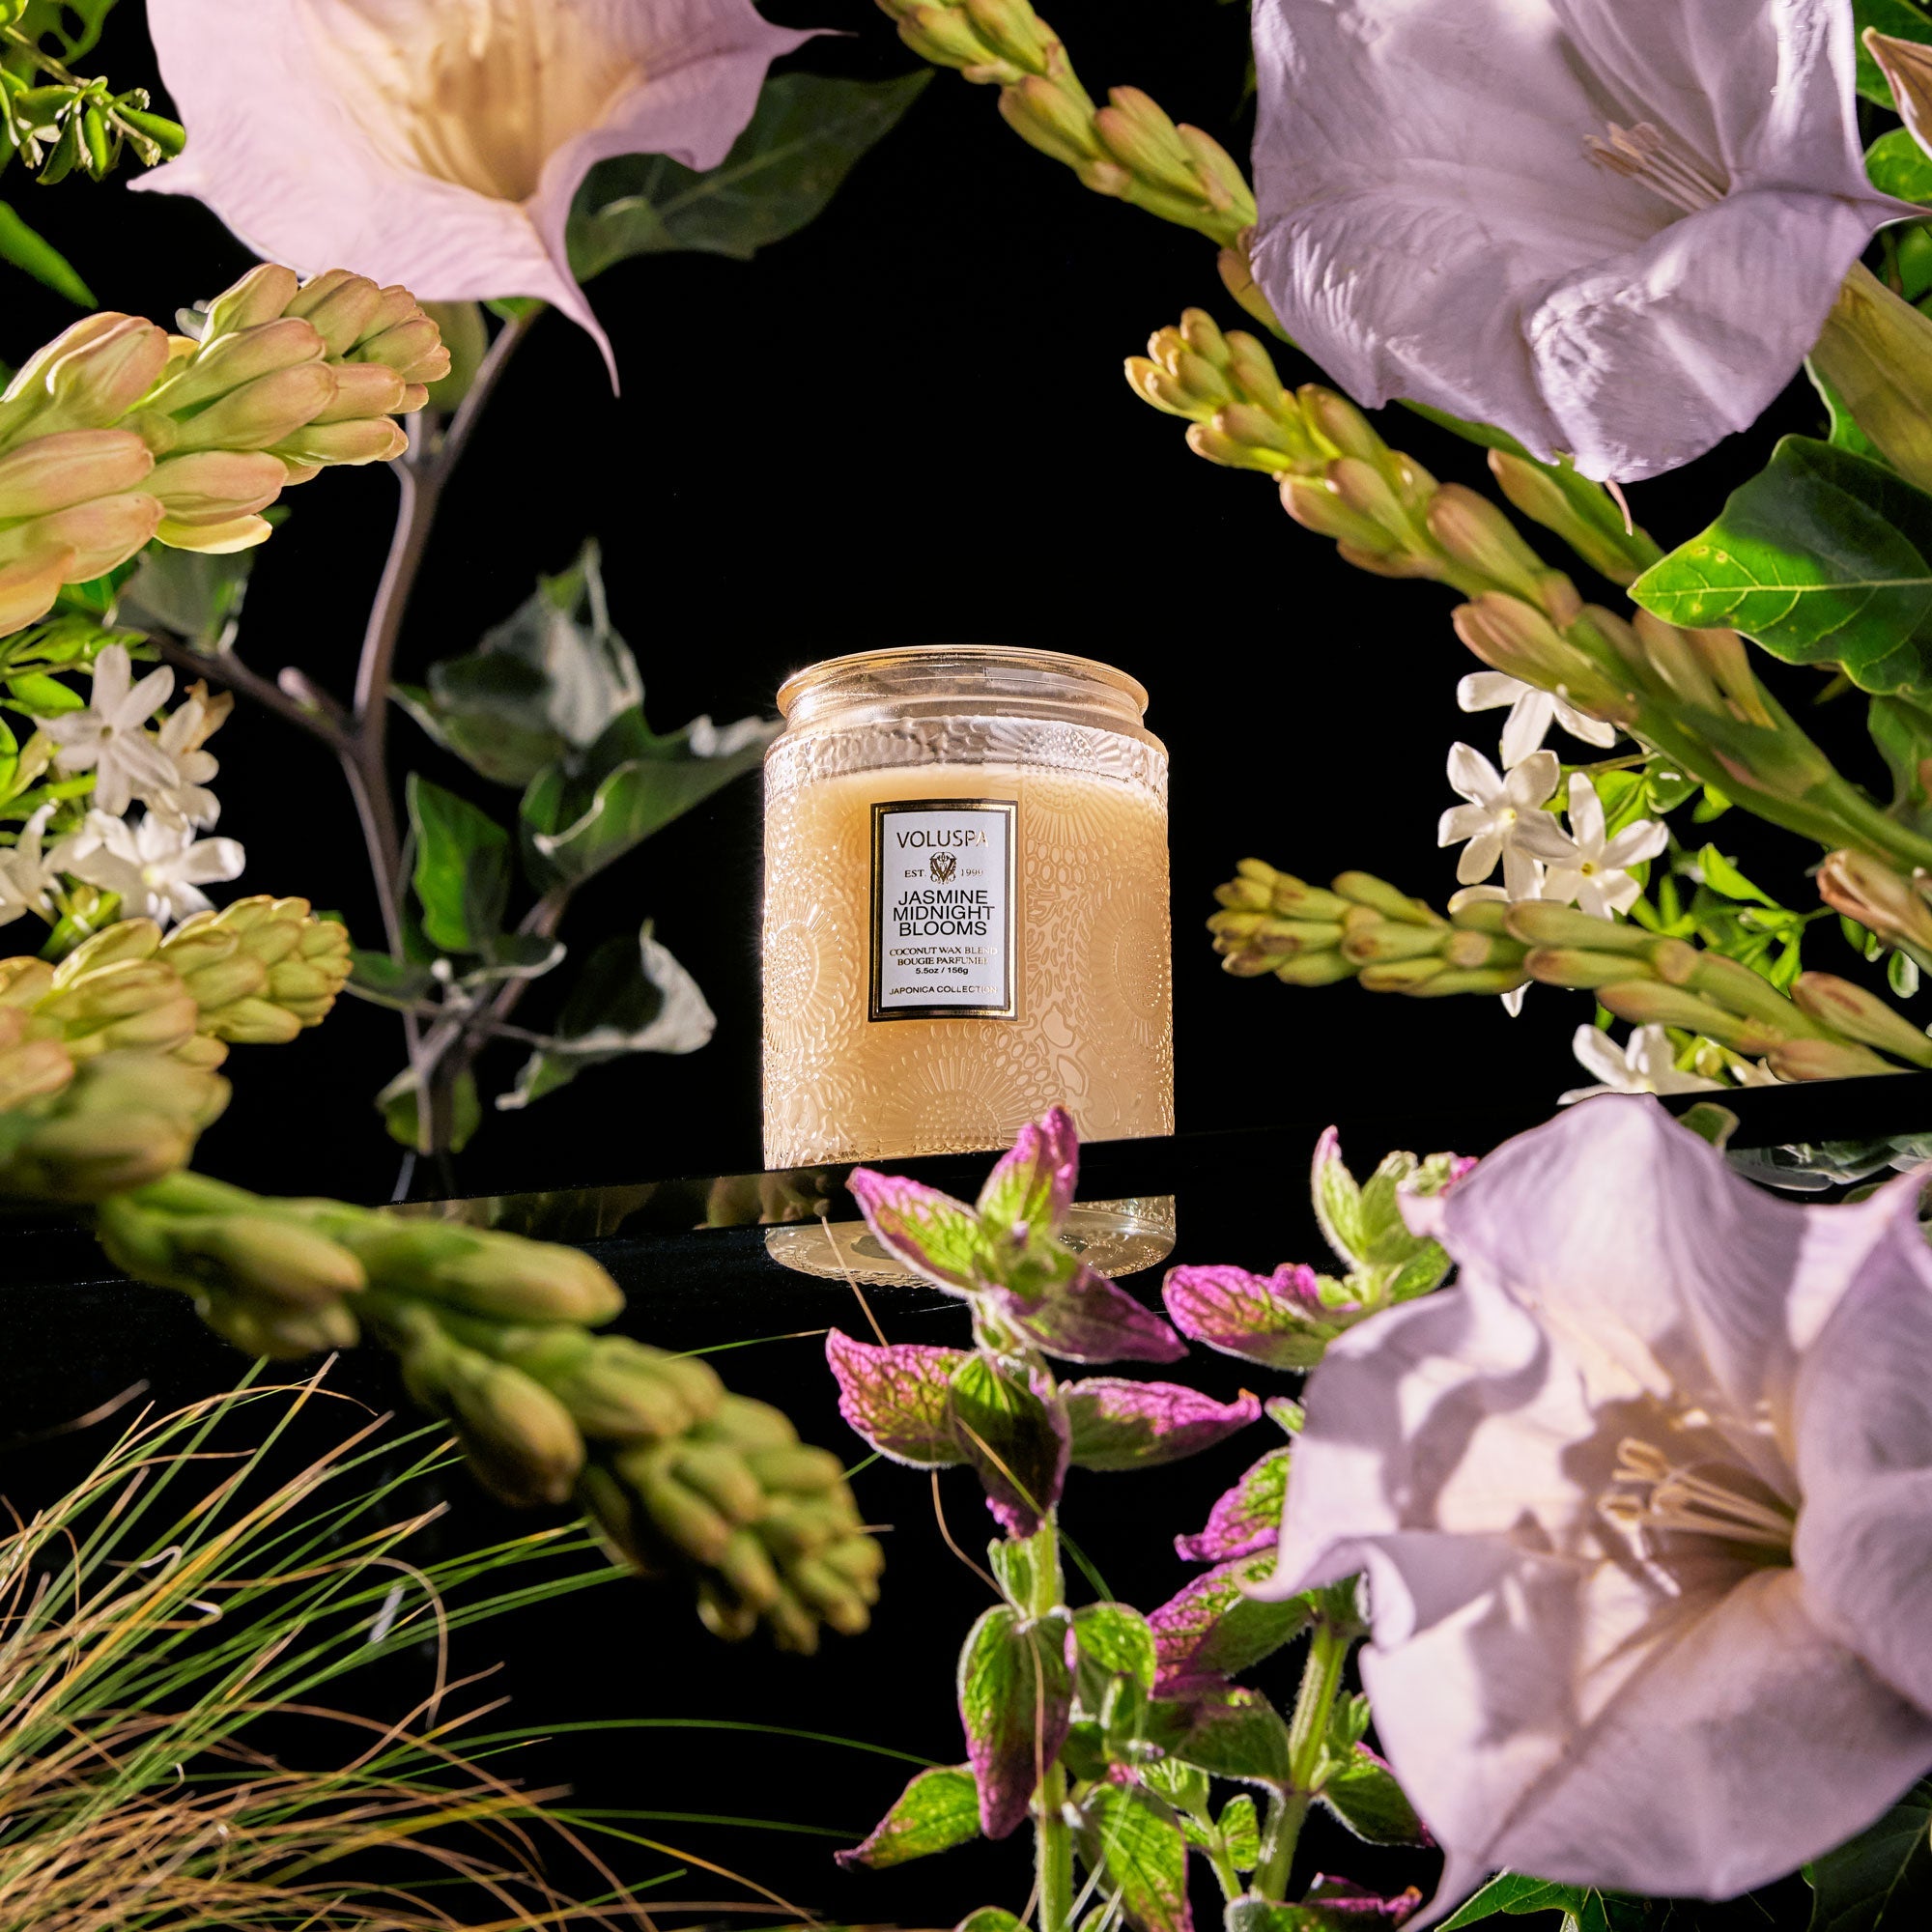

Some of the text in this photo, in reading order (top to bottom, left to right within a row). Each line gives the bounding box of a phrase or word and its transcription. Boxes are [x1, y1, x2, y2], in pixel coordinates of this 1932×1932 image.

[896, 830, 989, 848] VOLUSPA
[904, 869, 926, 878] EST.
[961, 868, 983, 877] 1999
[898, 890, 988, 906] JASMINE
[893, 905, 995, 922] MIDNIGHT
[899, 921, 987, 937] BLOOMS
[889, 947, 937, 956] COCONUT
[964, 947, 998, 955] BLEND
[897, 957, 934, 966] BOUGIE
[889, 985, 998, 995] JAPONICA COLLECTION
